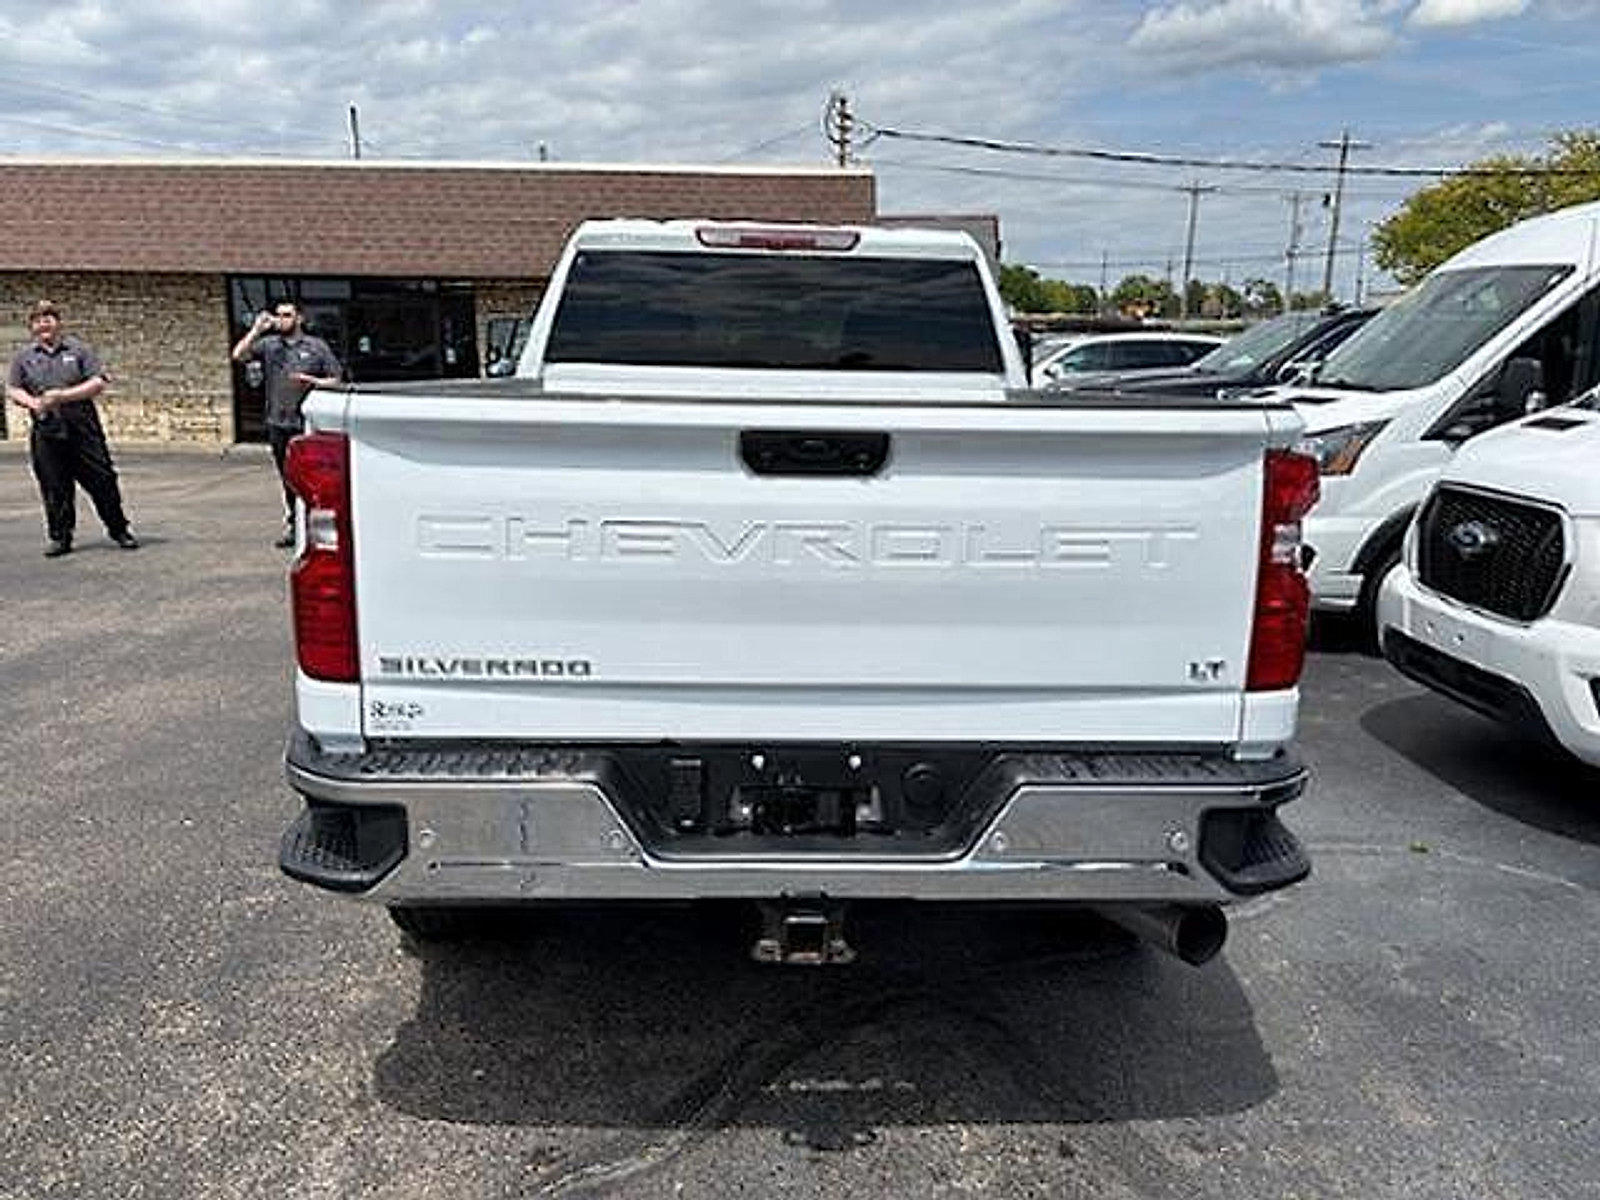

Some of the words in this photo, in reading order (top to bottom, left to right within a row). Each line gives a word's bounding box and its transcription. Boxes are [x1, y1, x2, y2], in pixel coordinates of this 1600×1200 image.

[417, 514, 1198, 570] CHEVROLET
[379, 656, 592, 677] SILVERADO
[1188, 660, 1225, 681] LT
